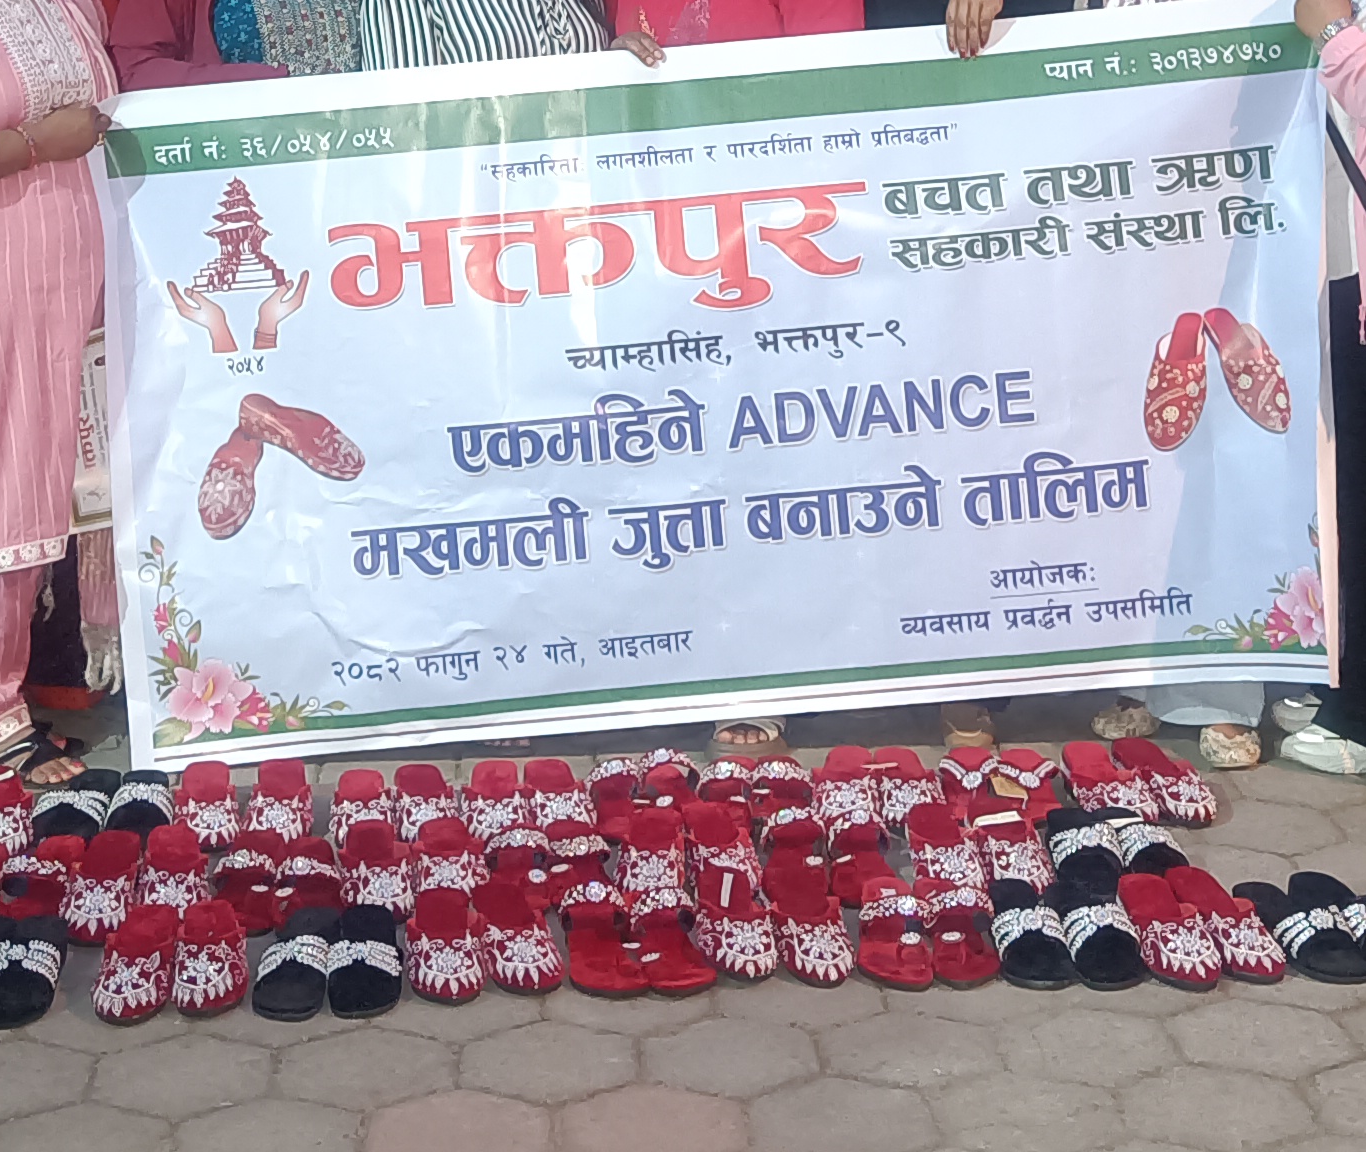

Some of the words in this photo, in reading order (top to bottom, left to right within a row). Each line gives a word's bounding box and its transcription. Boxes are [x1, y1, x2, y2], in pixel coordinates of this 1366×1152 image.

[1044, 57, 1093, 82] प्यान
[1149, 39, 1282, 76] ३०१३७४७५०
[154, 136, 192, 166] दर्ता
[239, 126, 395, 162] ३६/०५४/०५५
[596, 145, 694, 170] लगनशीलता
[703, 145, 717, 162] र
[726, 132, 812, 159] पारदर्शिता
[822, 128, 861, 154] हाम्रो
[882, 171, 1007, 220] बचत
[1024, 157, 1136, 209] तथा
[1150, 144, 1276, 193] ऋण
[327, 182, 866, 310] भक्तपुर
[890, 217, 1070, 271] सहकारी
[1085, 207, 1204, 252] संस्था
[1218, 197, 1287, 237] लि.
[226, 355, 264, 376] २०५४
[447, 387, 707, 476] एकमहिने
[728, 370, 1036, 452] ADVANCE
[350, 496, 589, 579] मखमली
[746, 464, 943, 545] बनाउने
[961, 451, 1151, 528] तालिम
[901, 607, 991, 635] व्यवसाय
[1085, 588, 1194, 621] उपसमिति
[416, 648, 481, 682] फागुन
[494, 645, 526, 667] २४
[543, 638, 586, 667] गते,
[597, 629, 693, 660] आइतबार
